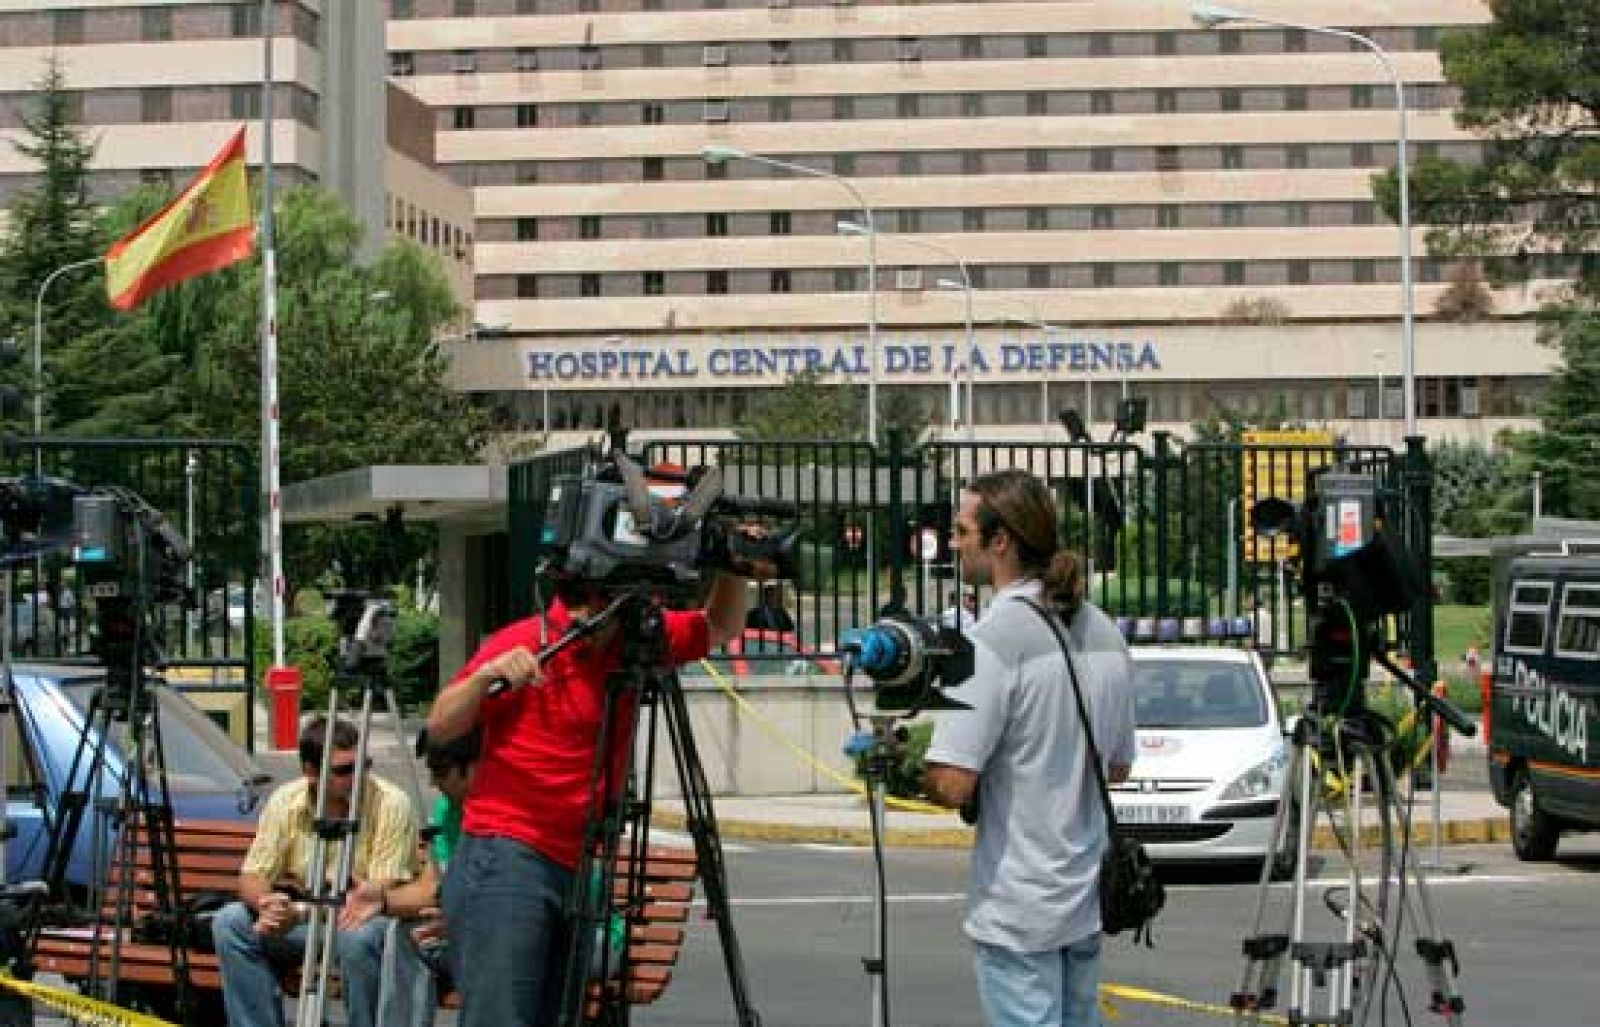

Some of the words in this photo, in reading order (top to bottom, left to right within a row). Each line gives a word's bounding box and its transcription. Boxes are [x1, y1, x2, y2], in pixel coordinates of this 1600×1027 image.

[528, 350, 699, 379] HOSPITAL
[708, 347, 870, 376] CENTRAL
[884, 345, 932, 373] DE
[942, 345, 991, 373] LA
[1000, 341, 1161, 372] DEFENSA
[1512, 660, 1587, 764] POLICIA
